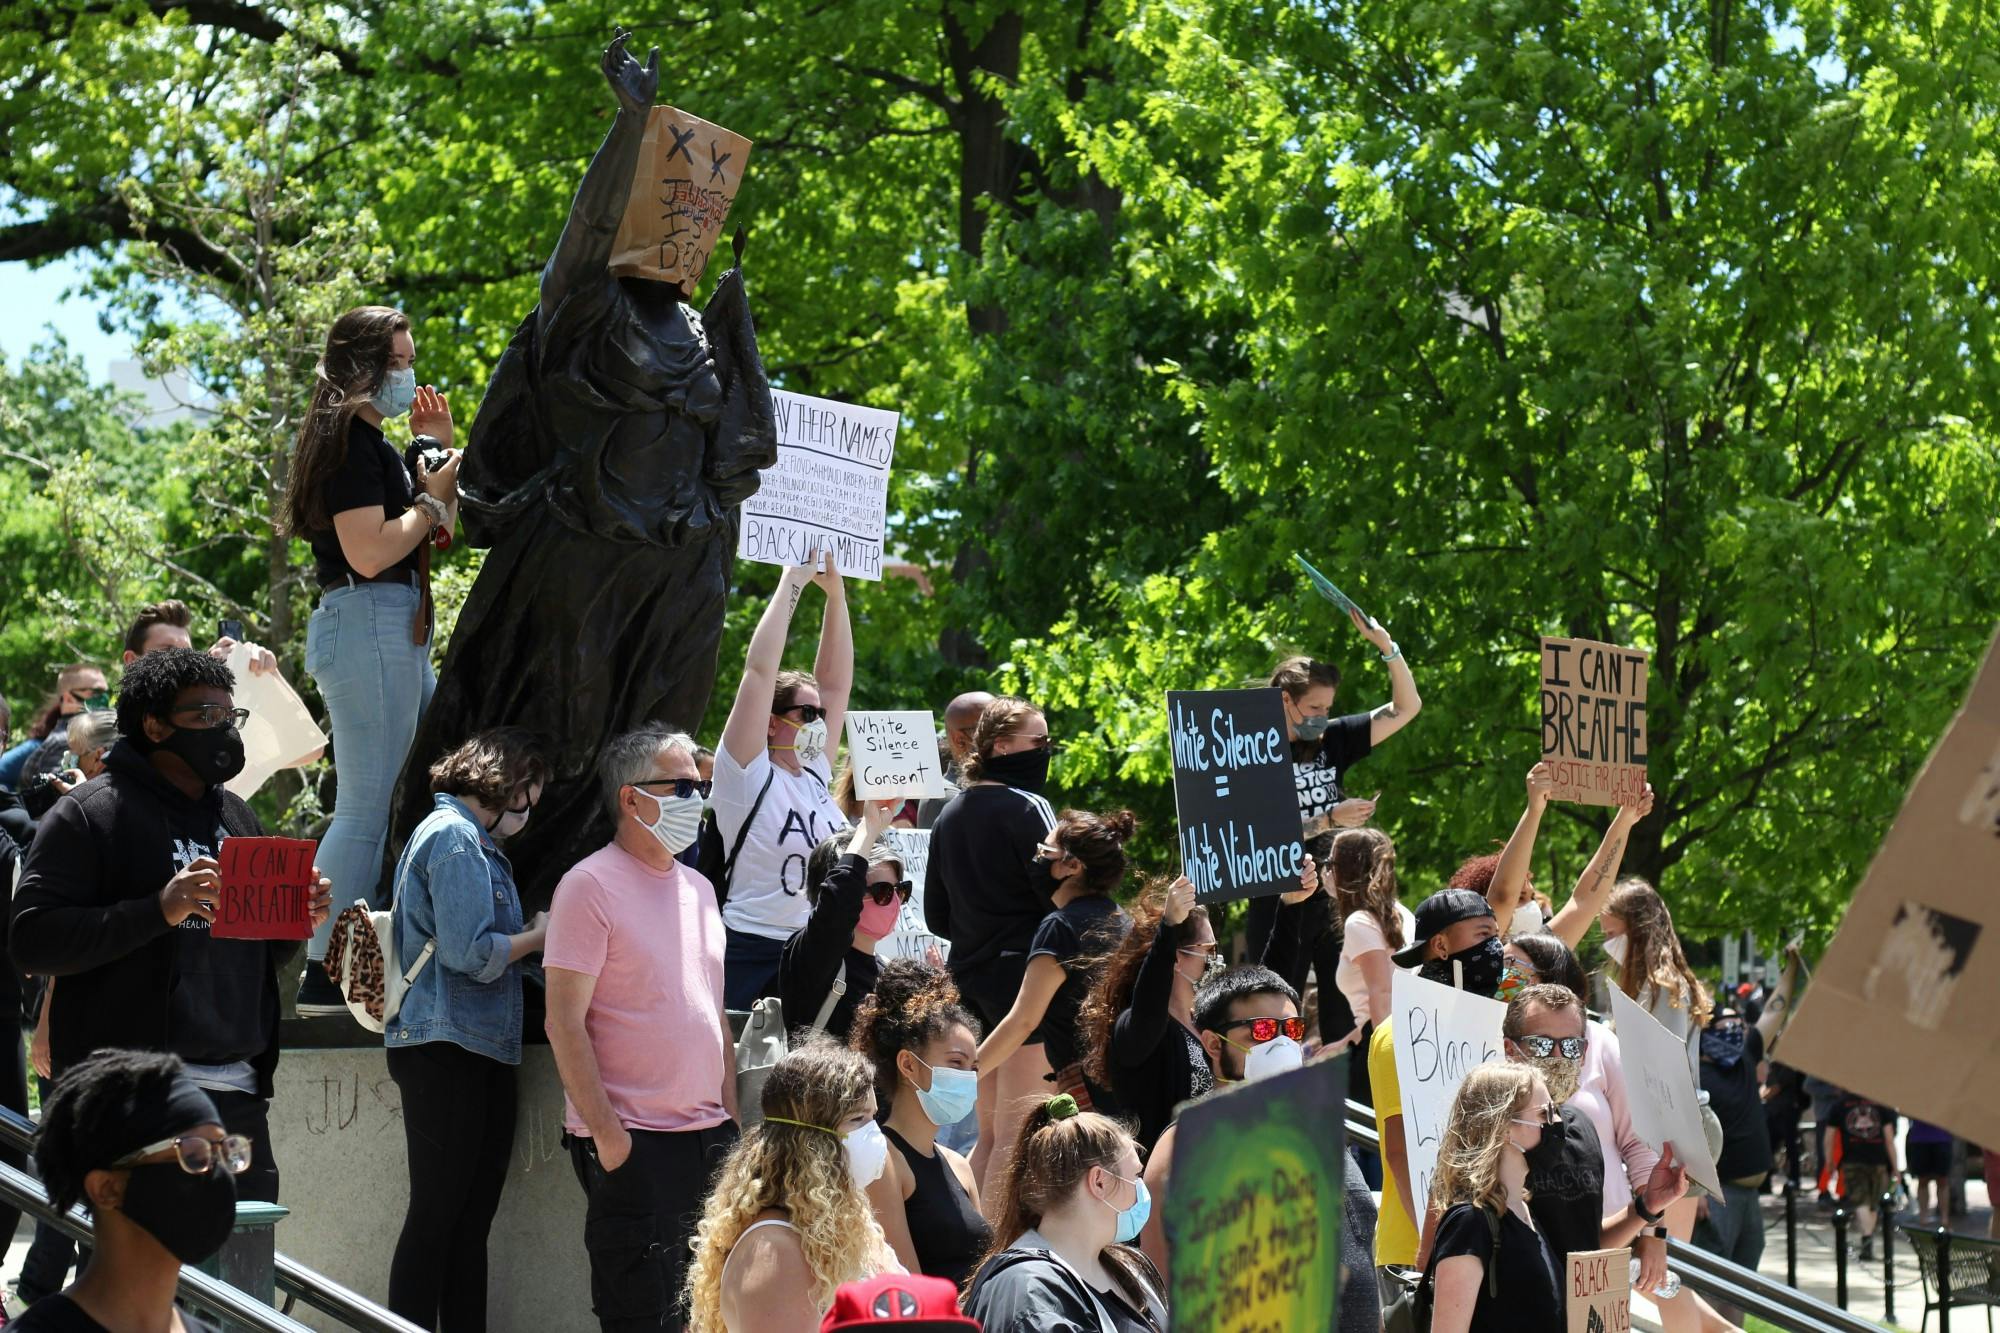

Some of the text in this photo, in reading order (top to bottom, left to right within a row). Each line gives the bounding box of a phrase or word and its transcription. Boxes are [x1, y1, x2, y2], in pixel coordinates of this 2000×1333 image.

[773, 396, 791, 446] AY
[794, 403, 836, 447] THEIR
[839, 416, 893, 464] NAMES
[747, 520, 799, 561] BLACK
[836, 534, 880, 577] MATTER
[1545, 643, 1570, 687] I
[853, 715, 907, 735] White
[867, 737, 920, 752] Silence
[1169, 700, 1283, 772] White Silence
[1542, 689, 1648, 765] BREATHE
[864, 761, 930, 786] Consent
[1543, 759, 1591, 790] JUSTICE
[231, 845, 240, 875] I
[1181, 820, 1304, 895] White Violence
[178, 919, 211, 929] HEALIN
[224, 884, 306, 924] BREATHE
[1574, 1257, 1609, 1297] BLACK
[1603, 1297, 1630, 1333] LIVES
